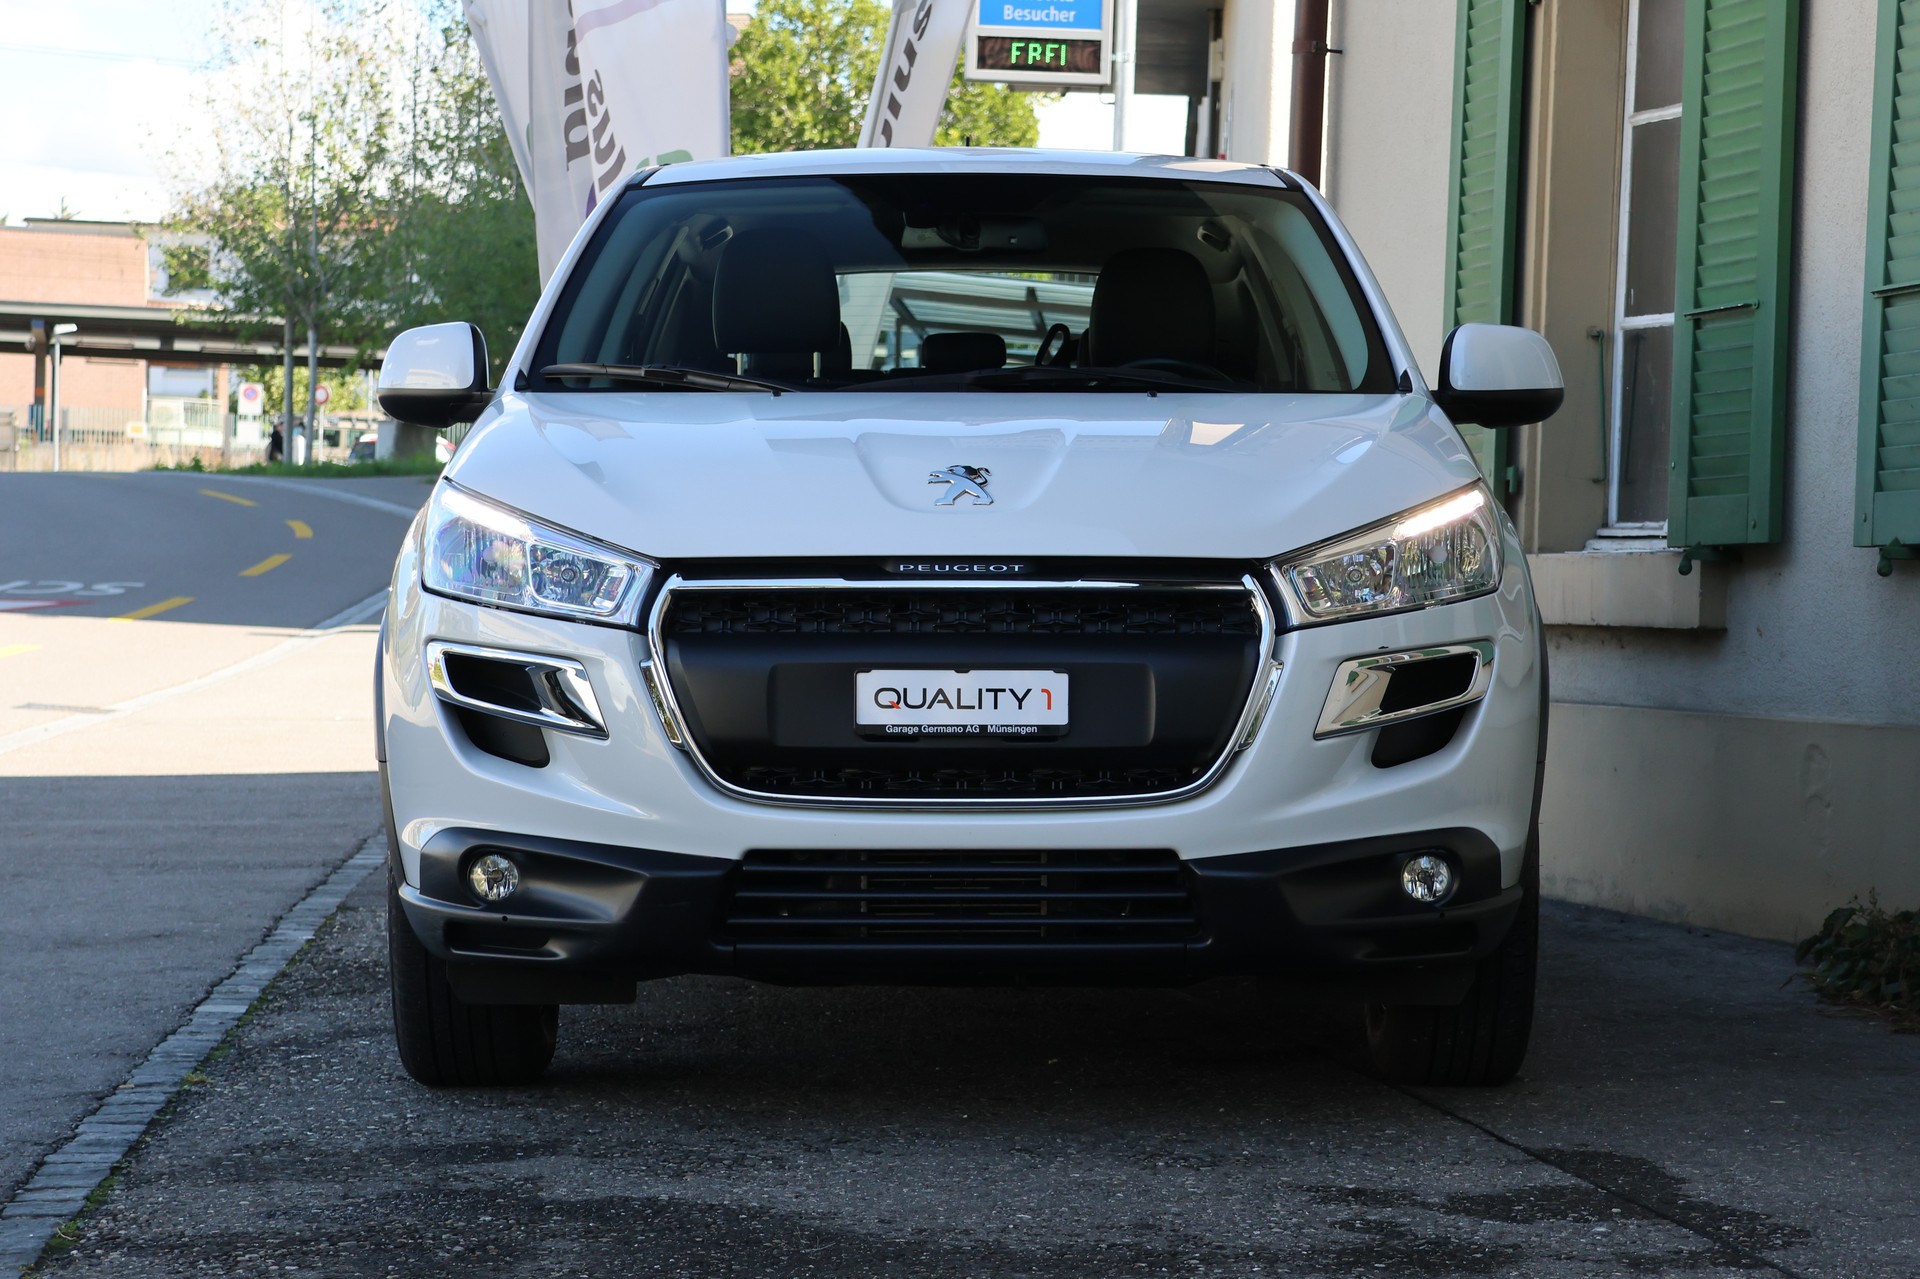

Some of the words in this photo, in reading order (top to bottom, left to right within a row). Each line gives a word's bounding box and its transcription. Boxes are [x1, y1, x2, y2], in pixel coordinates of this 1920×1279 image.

[1003, 4, 1077, 22] Besucher
[899, 564, 1024, 572] PEUGEOT
[874, 687, 1033, 710] QUALITY
[885, 725, 919, 735] Garage
[921, 725, 964, 734] Germano
[966, 725, 980, 734] AG
[987, 725, 1038, 735] Münsingen
